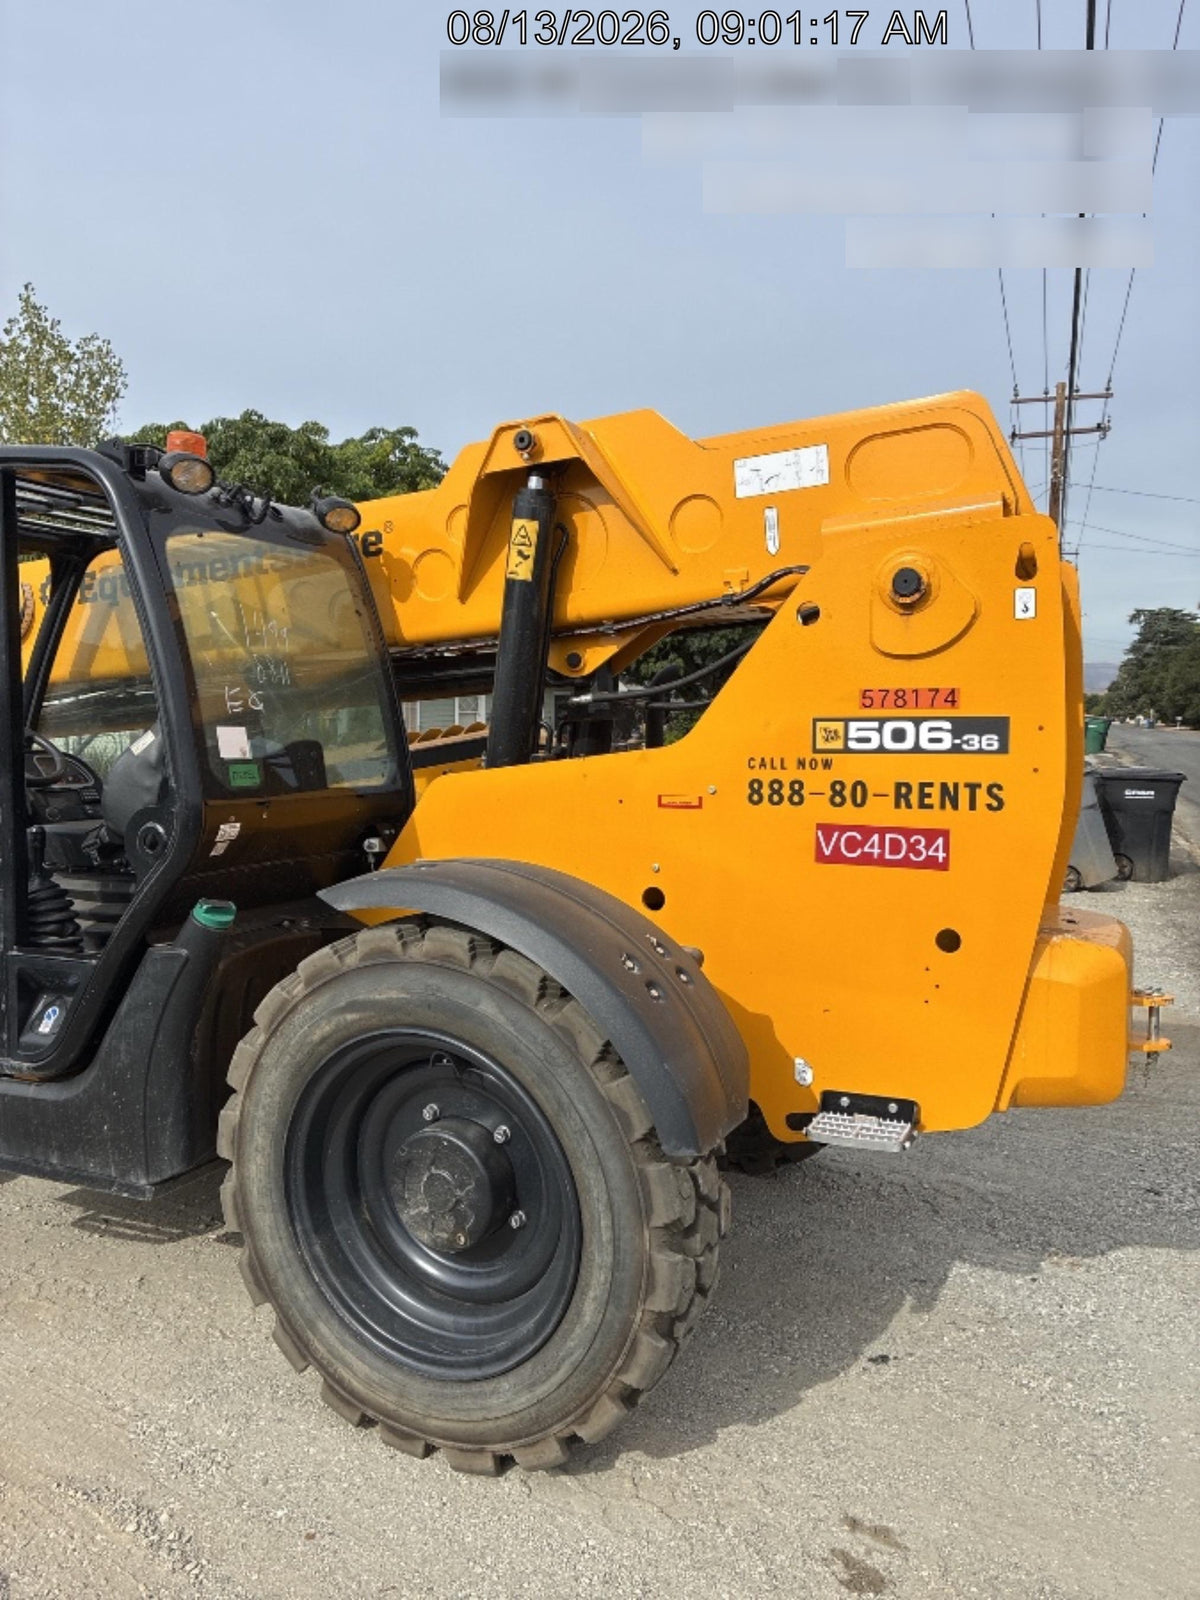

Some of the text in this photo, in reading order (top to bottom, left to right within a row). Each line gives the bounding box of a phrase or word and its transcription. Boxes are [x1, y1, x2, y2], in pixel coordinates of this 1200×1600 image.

[861, 687, 958, 709] 578174
[847, 719, 1000, 751] 506-36
[747, 757, 834, 771] CALL NOW
[747, 778, 1005, 812] 888-80-RENTS
[817, 829, 948, 863] VC4D34
